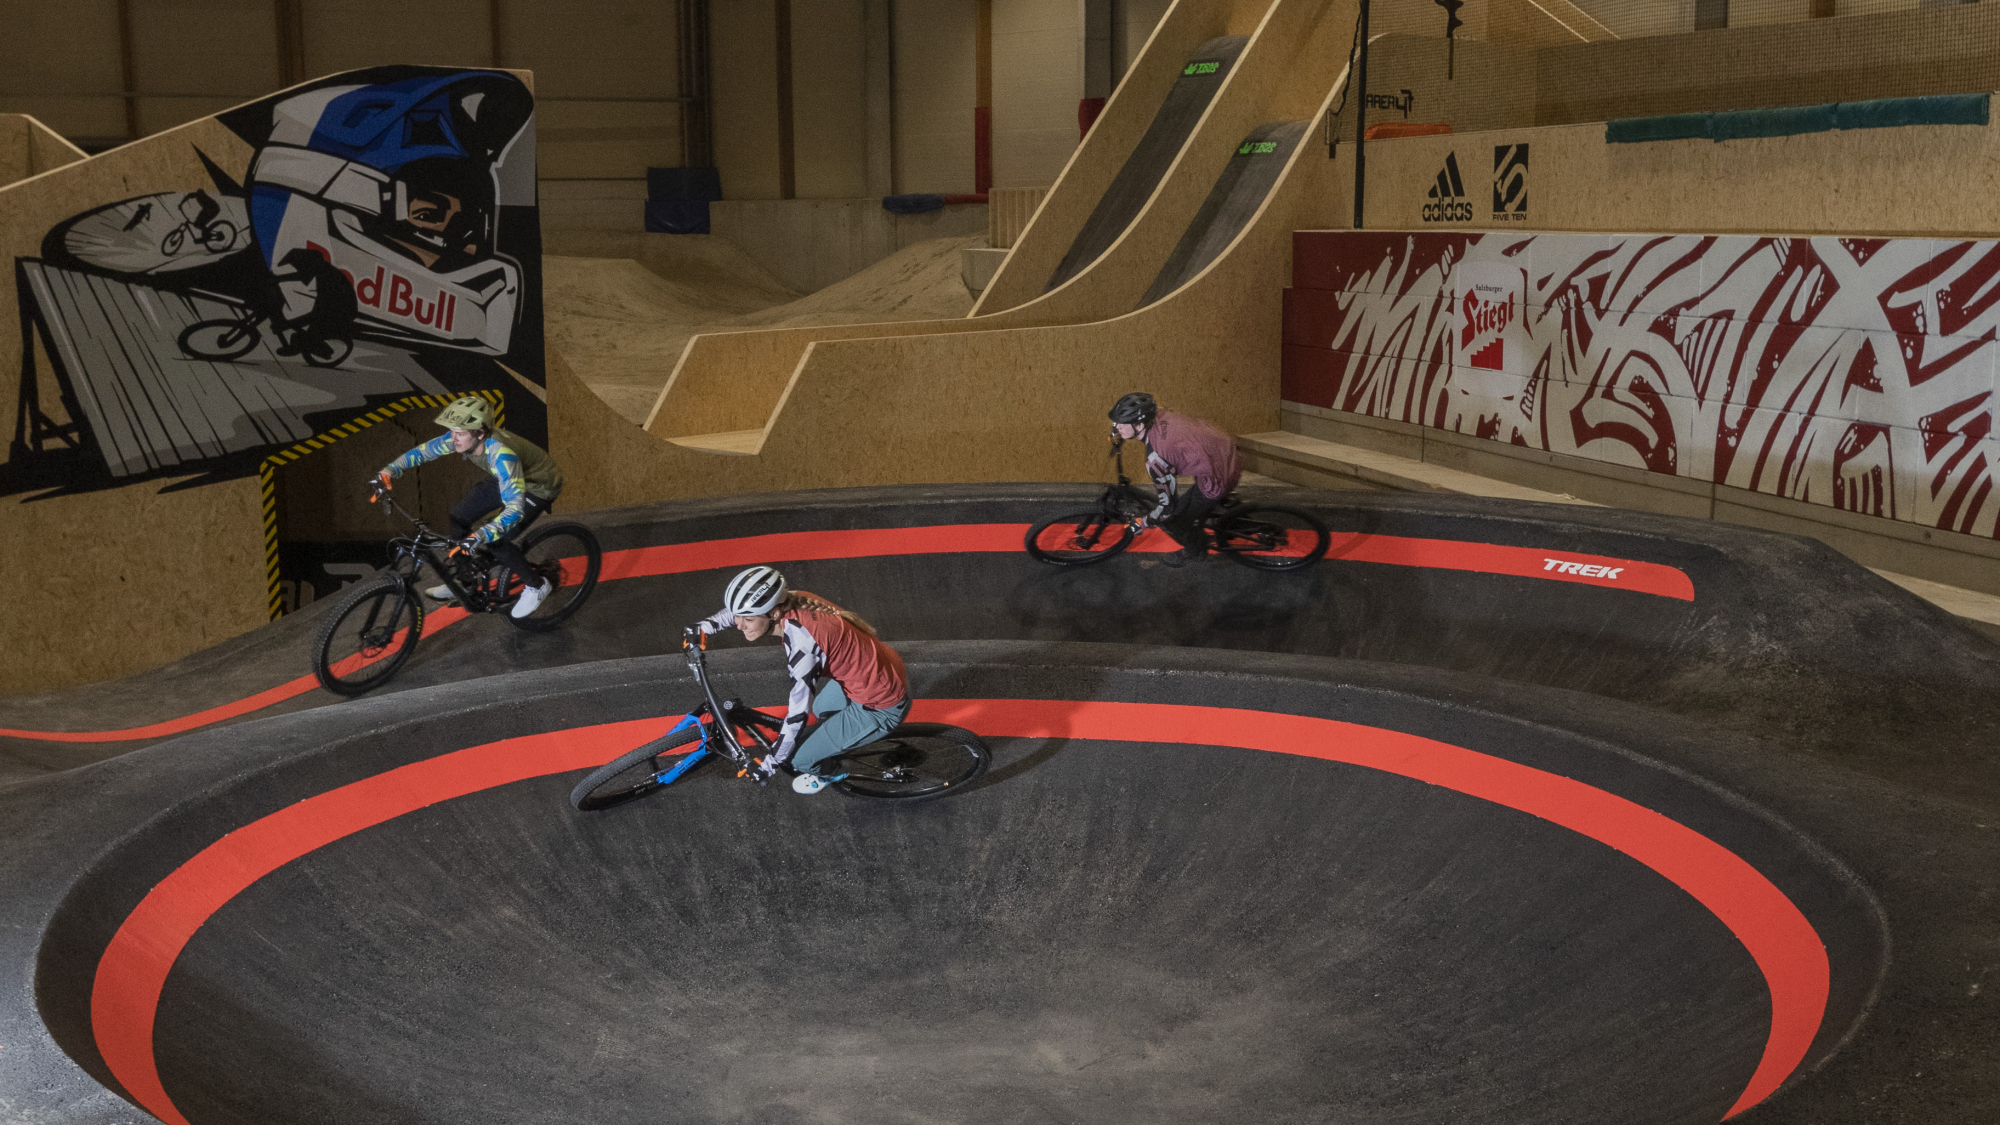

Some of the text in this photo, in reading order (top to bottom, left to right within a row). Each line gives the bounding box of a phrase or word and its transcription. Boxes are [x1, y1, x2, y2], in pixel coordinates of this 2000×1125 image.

[1422, 196, 1473, 222] adidas
[1511, 213, 1527, 221] TEN
[1475, 283, 1503, 294] Salzburger
[388, 273, 456, 332] Bull
[1461, 288, 1515, 351] Stiegl
[1543, 558, 1625, 579] TREK
